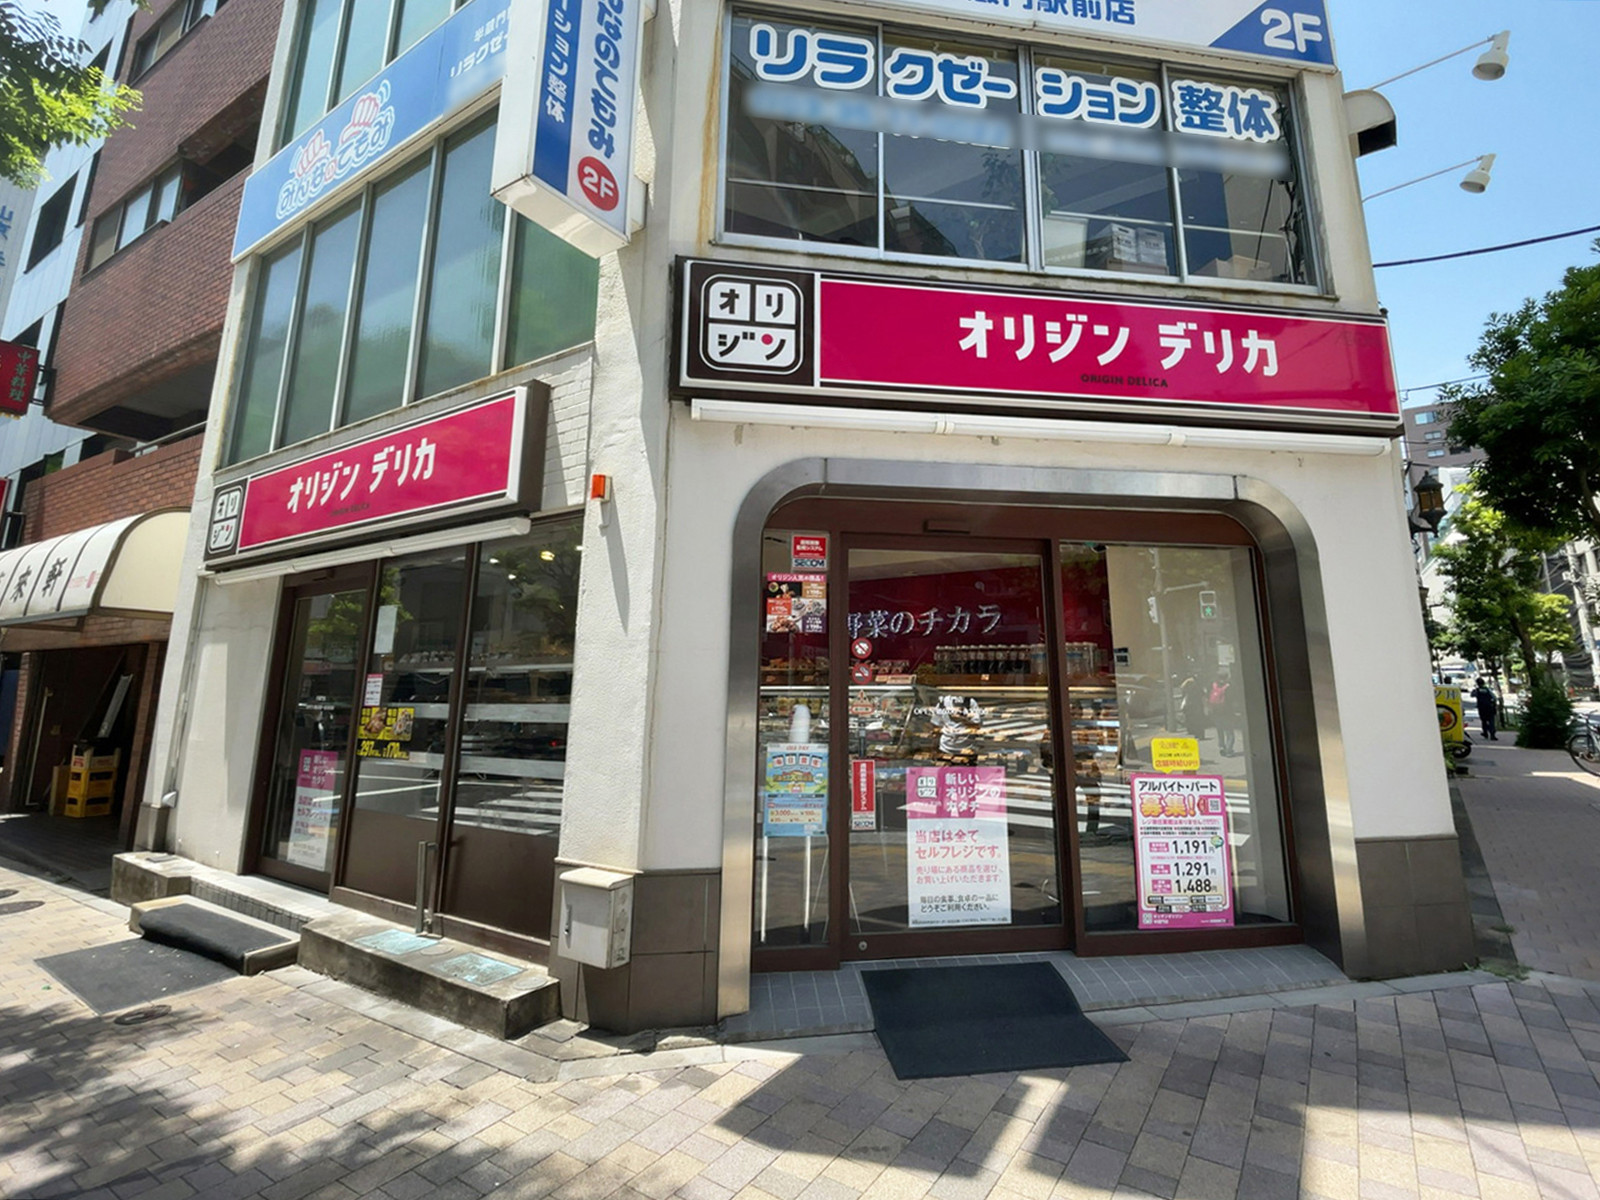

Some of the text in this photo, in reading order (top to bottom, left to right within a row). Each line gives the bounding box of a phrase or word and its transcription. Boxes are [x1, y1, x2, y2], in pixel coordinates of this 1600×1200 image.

[1260, 8, 1323, 53] 2F
[582, 165, 616, 199] 2F
[959, 311, 1279, 377] オリジン デリカ
[1081, 373, 1168, 388] ORIGIN DELICA
[287, 437, 437, 514] オリジン デリカ
[794, 559, 824, 567] SECOM
[945, 773, 979, 785] 新しい
[946, 786, 1000, 799] オリジンの
[946, 801, 980, 812] カタチ
[915, 829, 979, 844] 当店は全て
